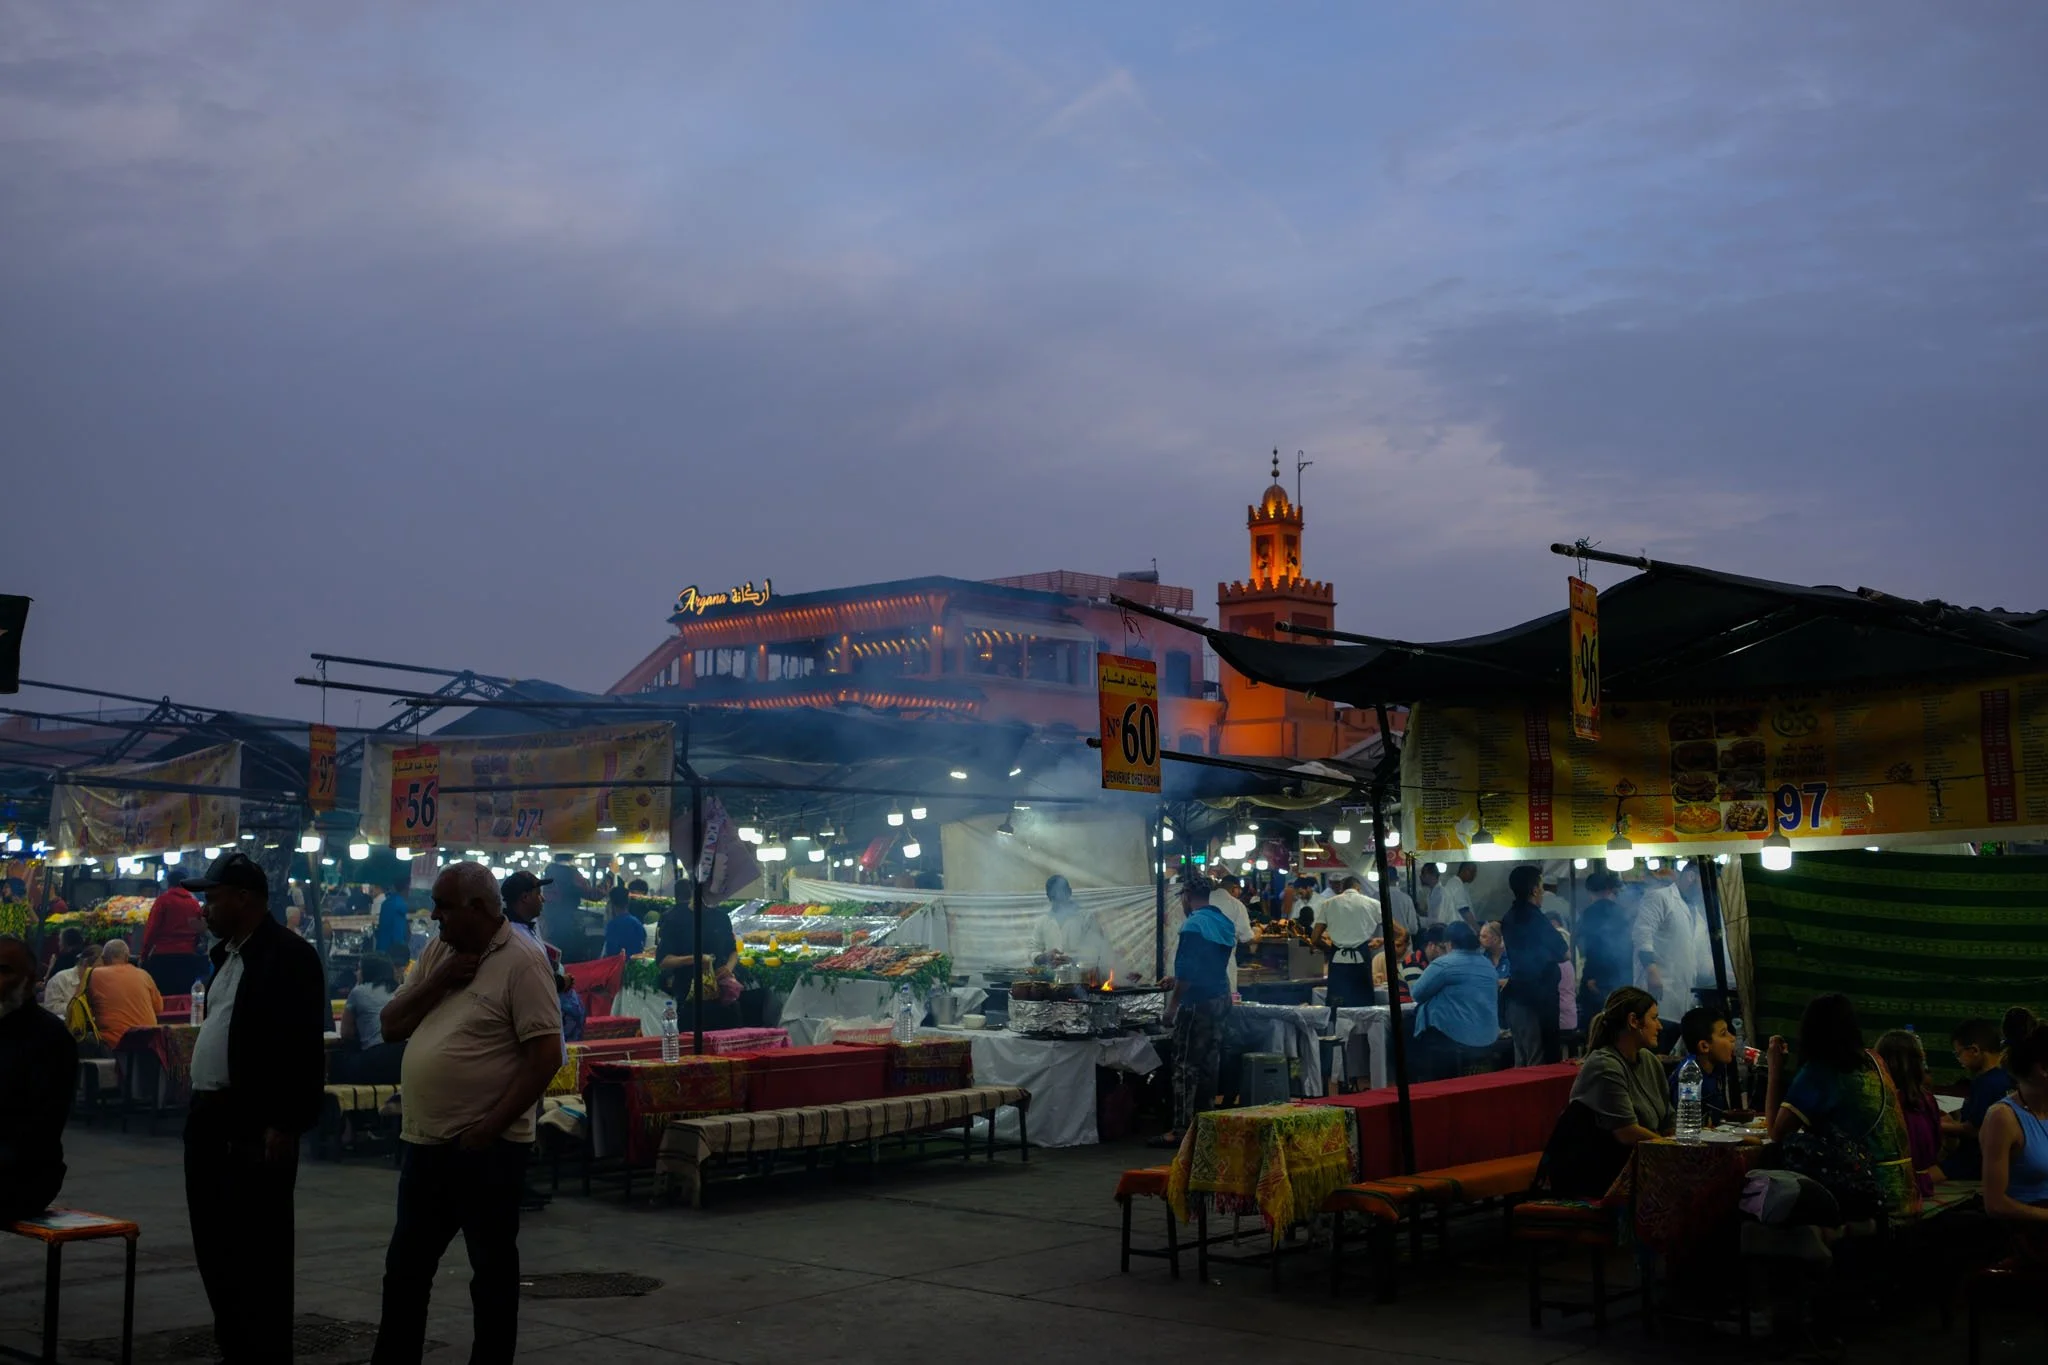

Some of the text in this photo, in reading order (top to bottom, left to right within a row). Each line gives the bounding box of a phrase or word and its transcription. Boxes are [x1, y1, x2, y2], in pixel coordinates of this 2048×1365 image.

[676, 585, 729, 616] Argana
[1121, 702, 1157, 767] 60
[406, 781, 435, 829] 56
[515, 807, 539, 838] 97
[1774, 781, 1828, 831] 97
